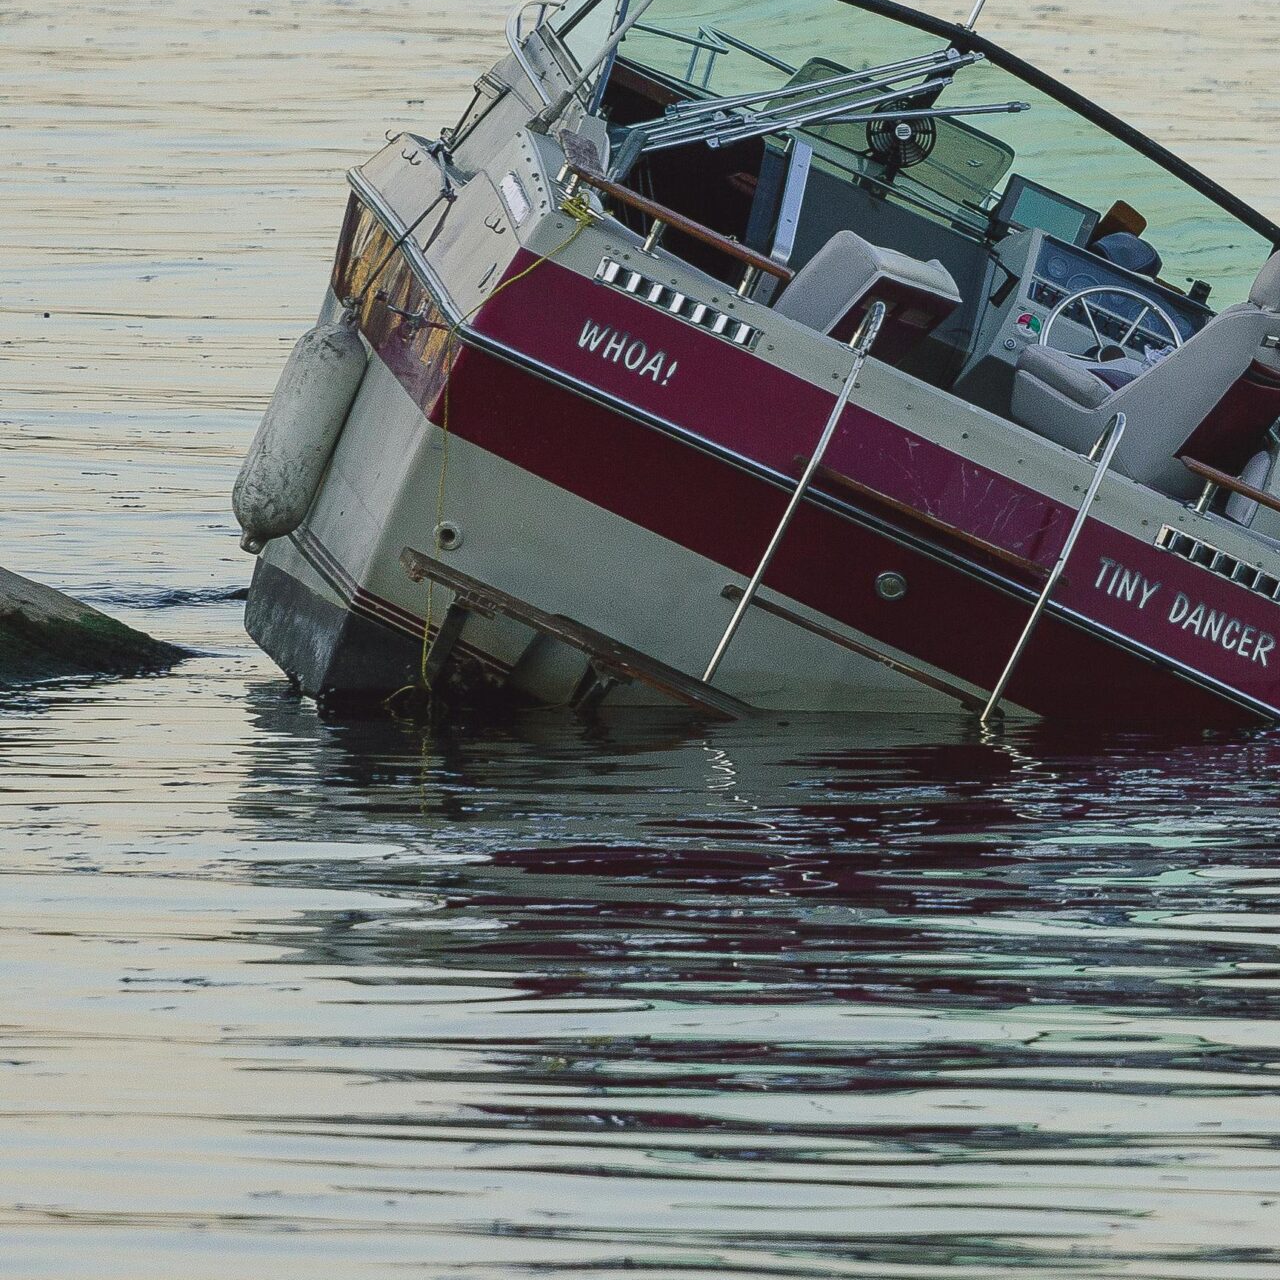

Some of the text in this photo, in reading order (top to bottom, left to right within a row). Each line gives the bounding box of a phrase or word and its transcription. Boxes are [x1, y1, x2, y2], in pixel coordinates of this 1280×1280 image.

[578, 319, 678, 385] WHOA!
[1095, 557, 1276, 667] TINY DANCER
